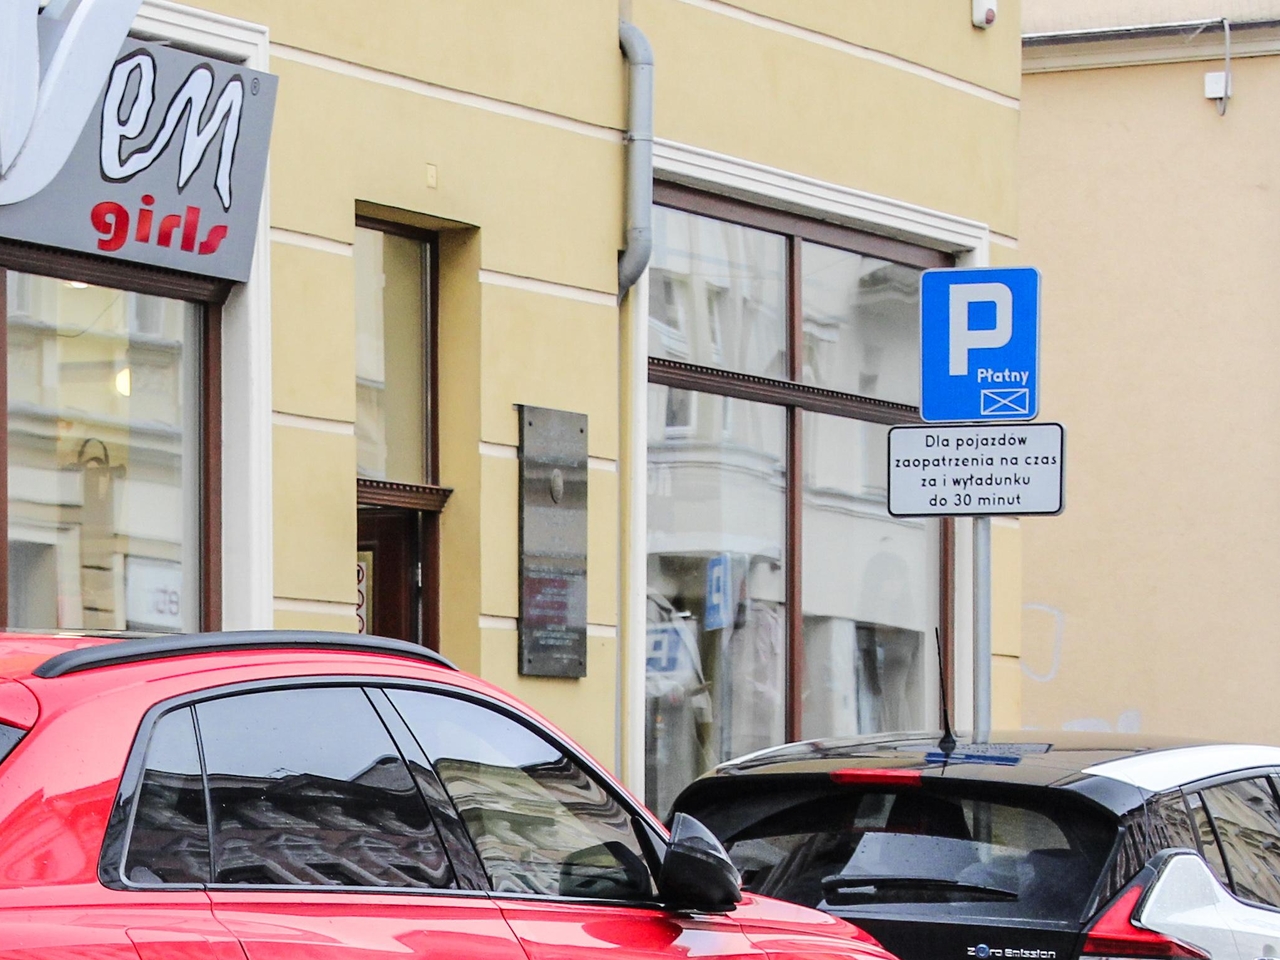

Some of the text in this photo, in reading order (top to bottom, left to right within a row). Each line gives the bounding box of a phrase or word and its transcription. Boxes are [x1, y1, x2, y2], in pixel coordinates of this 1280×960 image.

[90, 194, 228, 255] girls
[949, 282, 1013, 376] P
[977, 367, 1029, 386] Płatny
[925, 433, 1028, 450] Dla pojazdów
[895, 453, 1057, 471] zaopatrzenia na czas
[921, 473, 1031, 490] za i wyładunku
[929, 493, 1021, 507] do 30 minut
[1005, 948, 1056, 959] Emission
